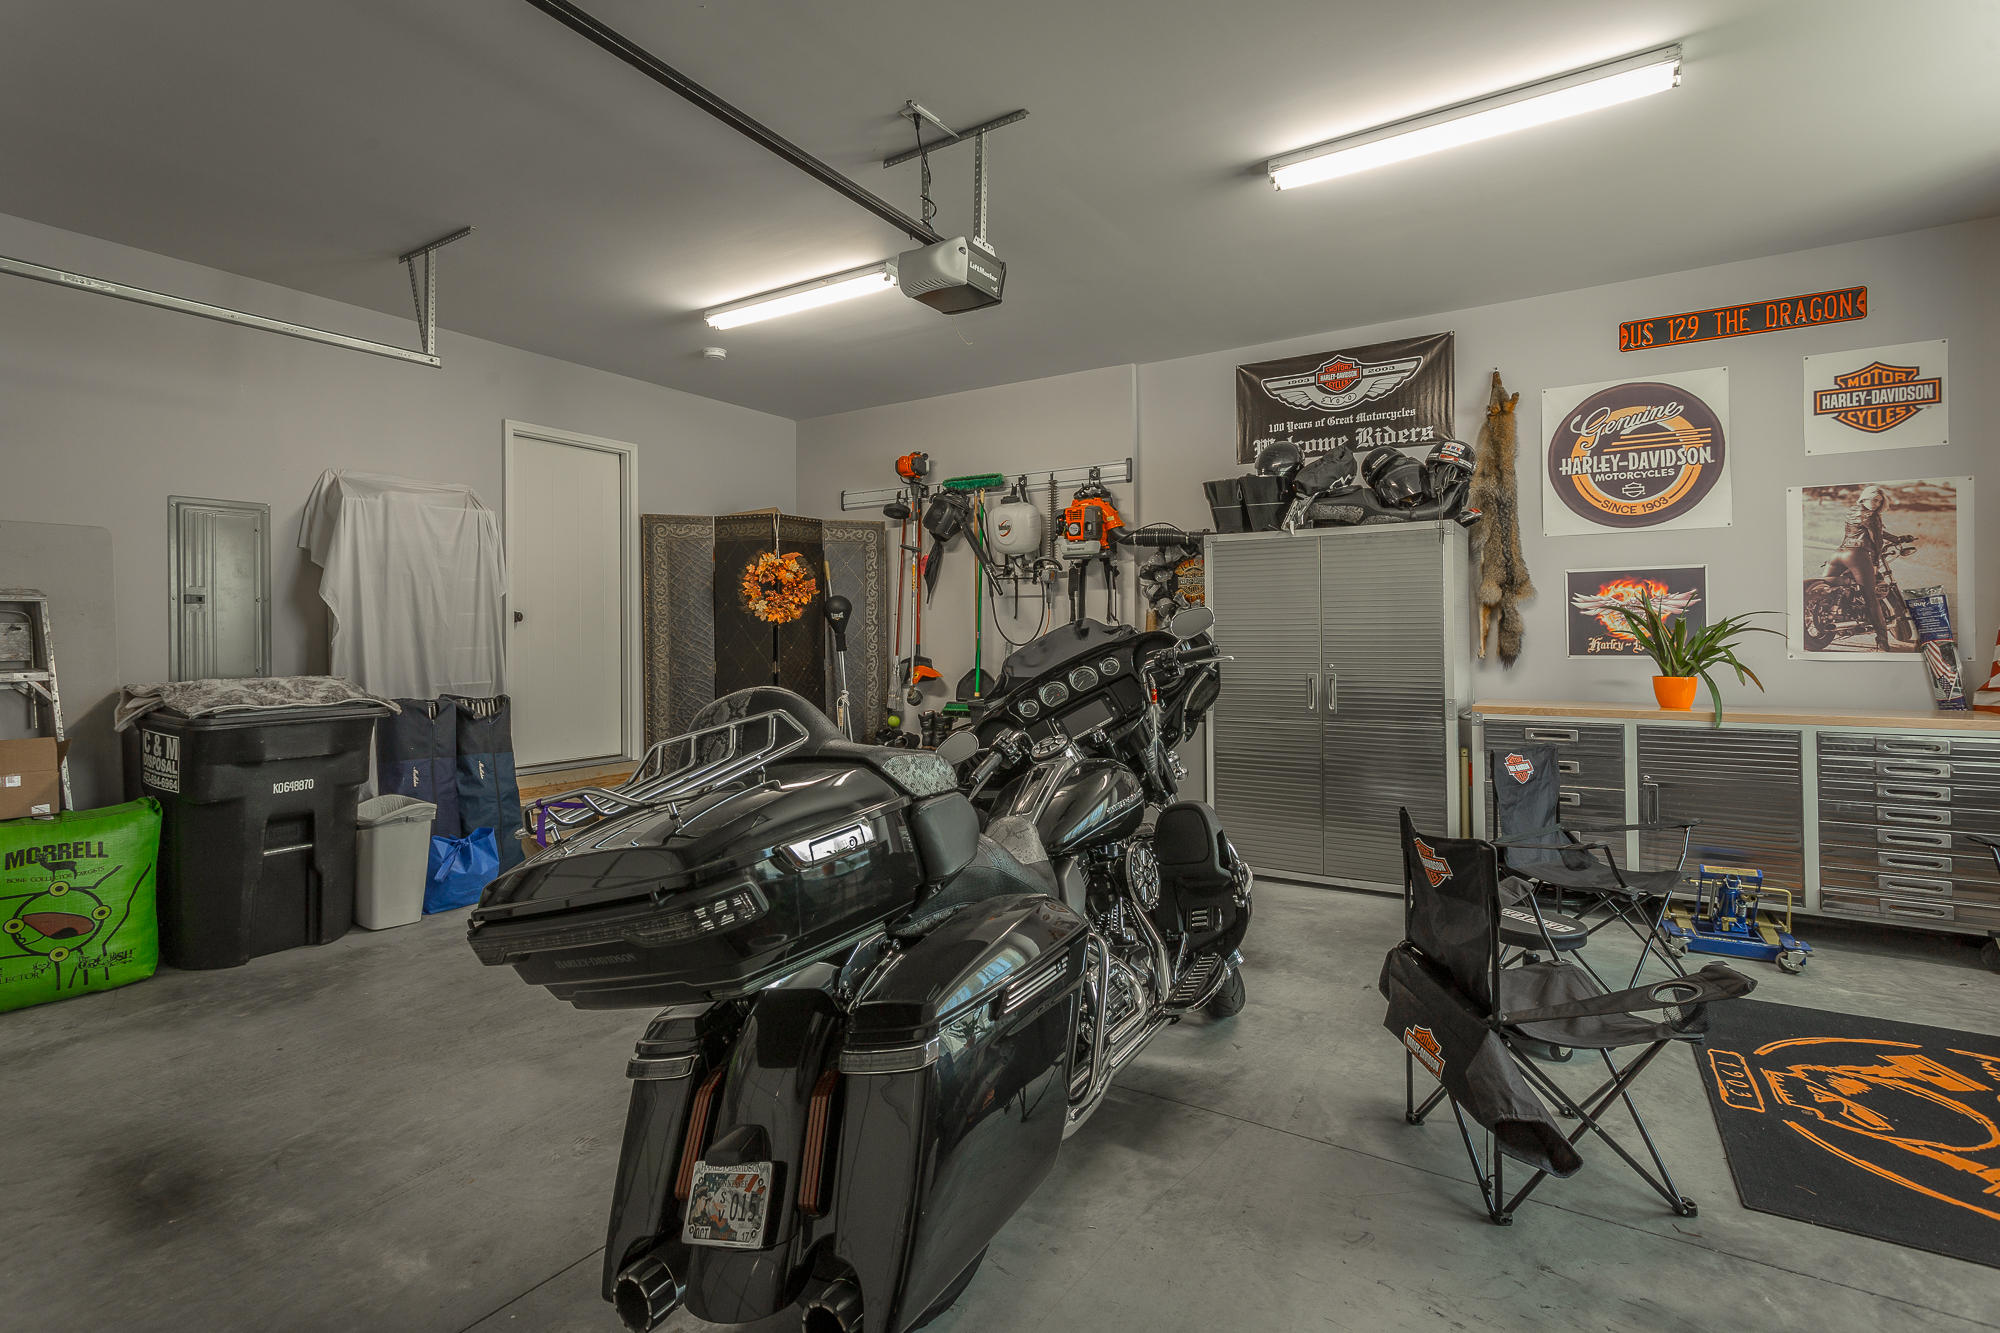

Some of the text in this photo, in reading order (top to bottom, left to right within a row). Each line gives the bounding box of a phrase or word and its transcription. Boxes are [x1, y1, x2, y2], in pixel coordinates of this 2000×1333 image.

[969, 261, 998, 282] LiftMaster
[1630, 292, 1853, 348] US 129 THE DRAGON
[1367, 365, 1396, 374] 2003
[1847, 368, 1907, 388] MOTOR
[1821, 384, 1934, 410] HARLEY-DAVIDSON
[1268, 408, 1416, 433] 100 Years of Great Motorcycles
[1570, 401, 1685, 451] Genuine
[1847, 406, 1906, 428] CYCLES
[1355, 425, 1434, 449] Riders
[1559, 446, 1713, 476] HARLEY-DAVIDSON
[1595, 468, 1675, 482] MOTORCYCLES
[1600, 496, 1670, 515] SINCE 1903
[144, 731, 178, 761] C & M
[143, 752, 178, 775] DISPOSAL
[5, 841, 109, 871] MORRELL
[1717, 1061, 1753, 1097] 1903
